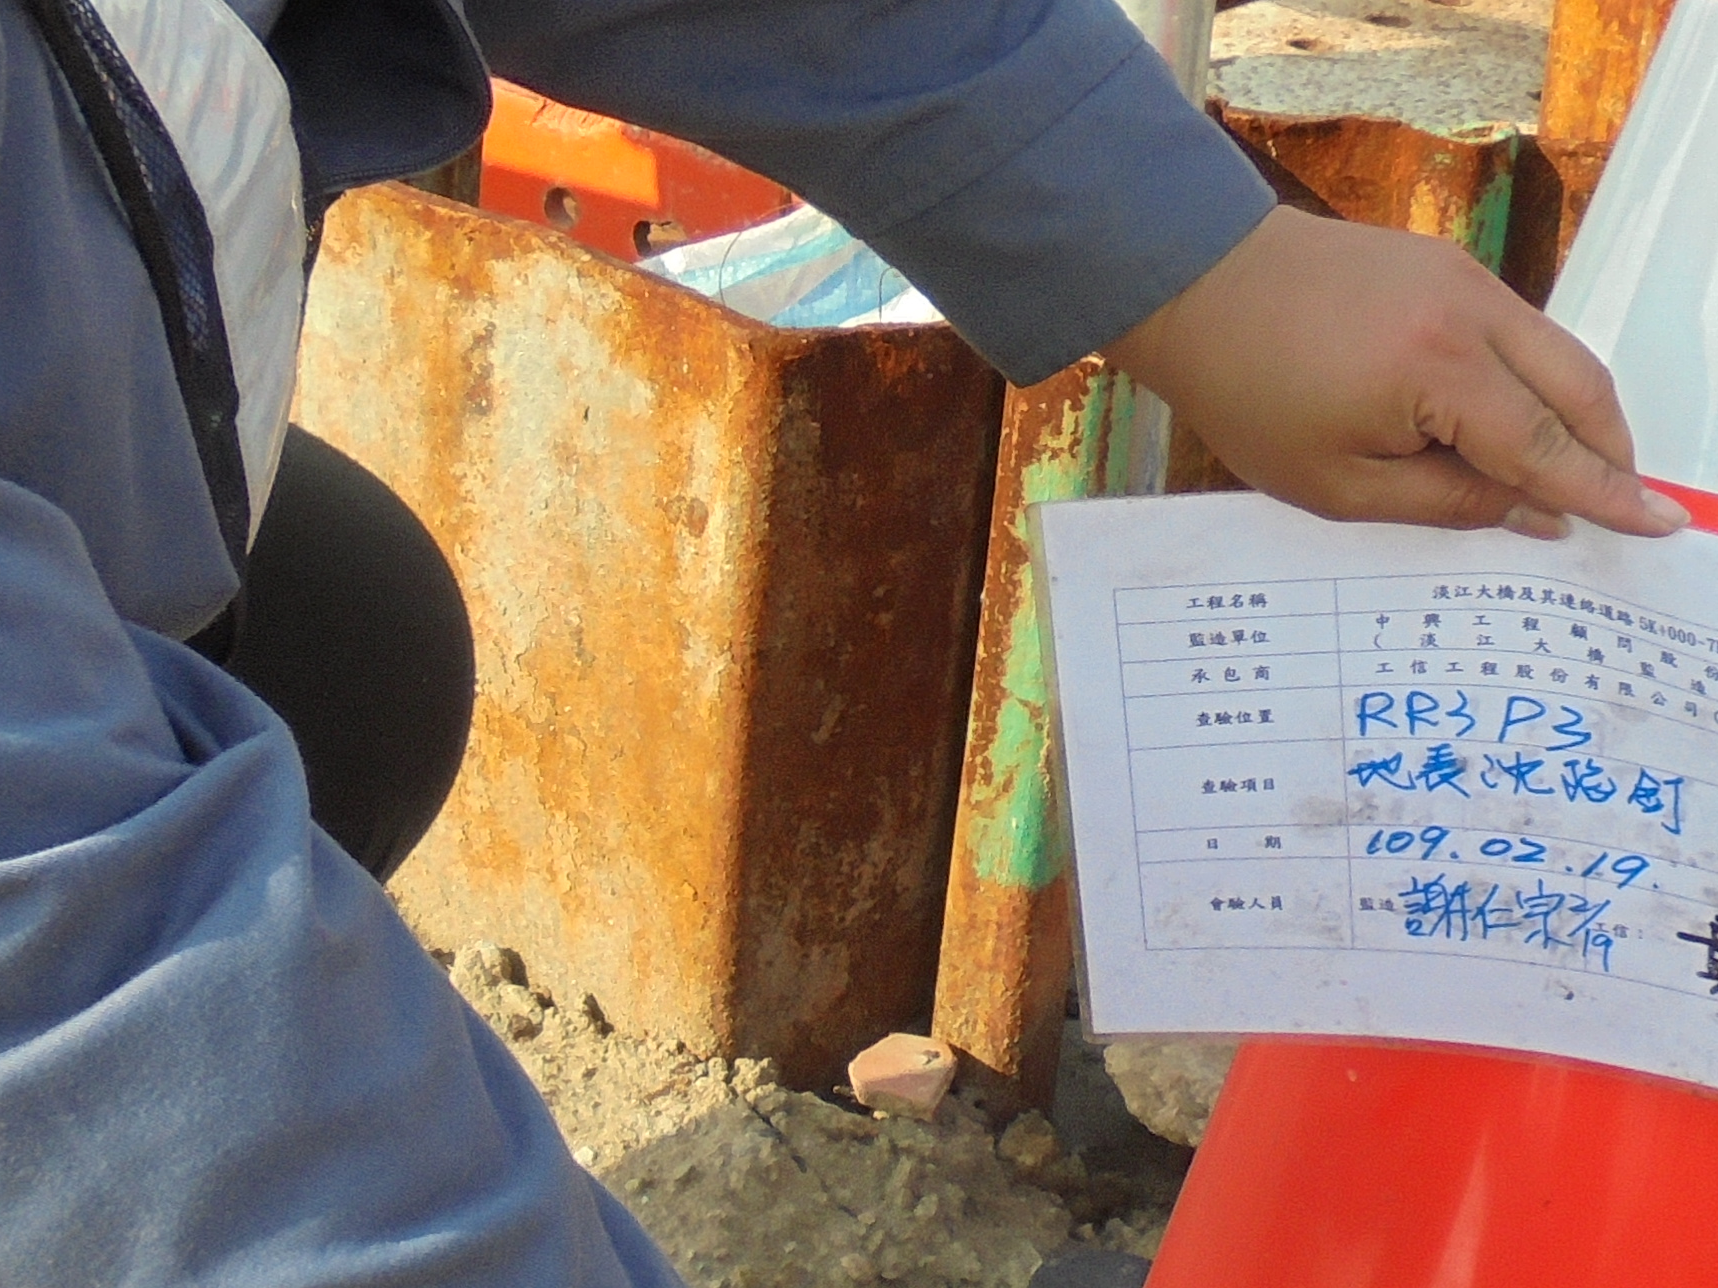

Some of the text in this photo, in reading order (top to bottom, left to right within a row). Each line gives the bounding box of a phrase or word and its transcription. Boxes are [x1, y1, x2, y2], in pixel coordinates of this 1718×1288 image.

[1186, 591, 1269, 610] 工程名稱
[1188, 629, 1271, 649] 監造單位
[1191, 665, 1272, 684] 承包商
[1196, 709, 1276, 727] 查驗位置
[1497, 695, 1593, 751] P3
[1201, 776, 1276, 795] 查驗項目
[1209, 895, 1284, 912] 會驗人員
